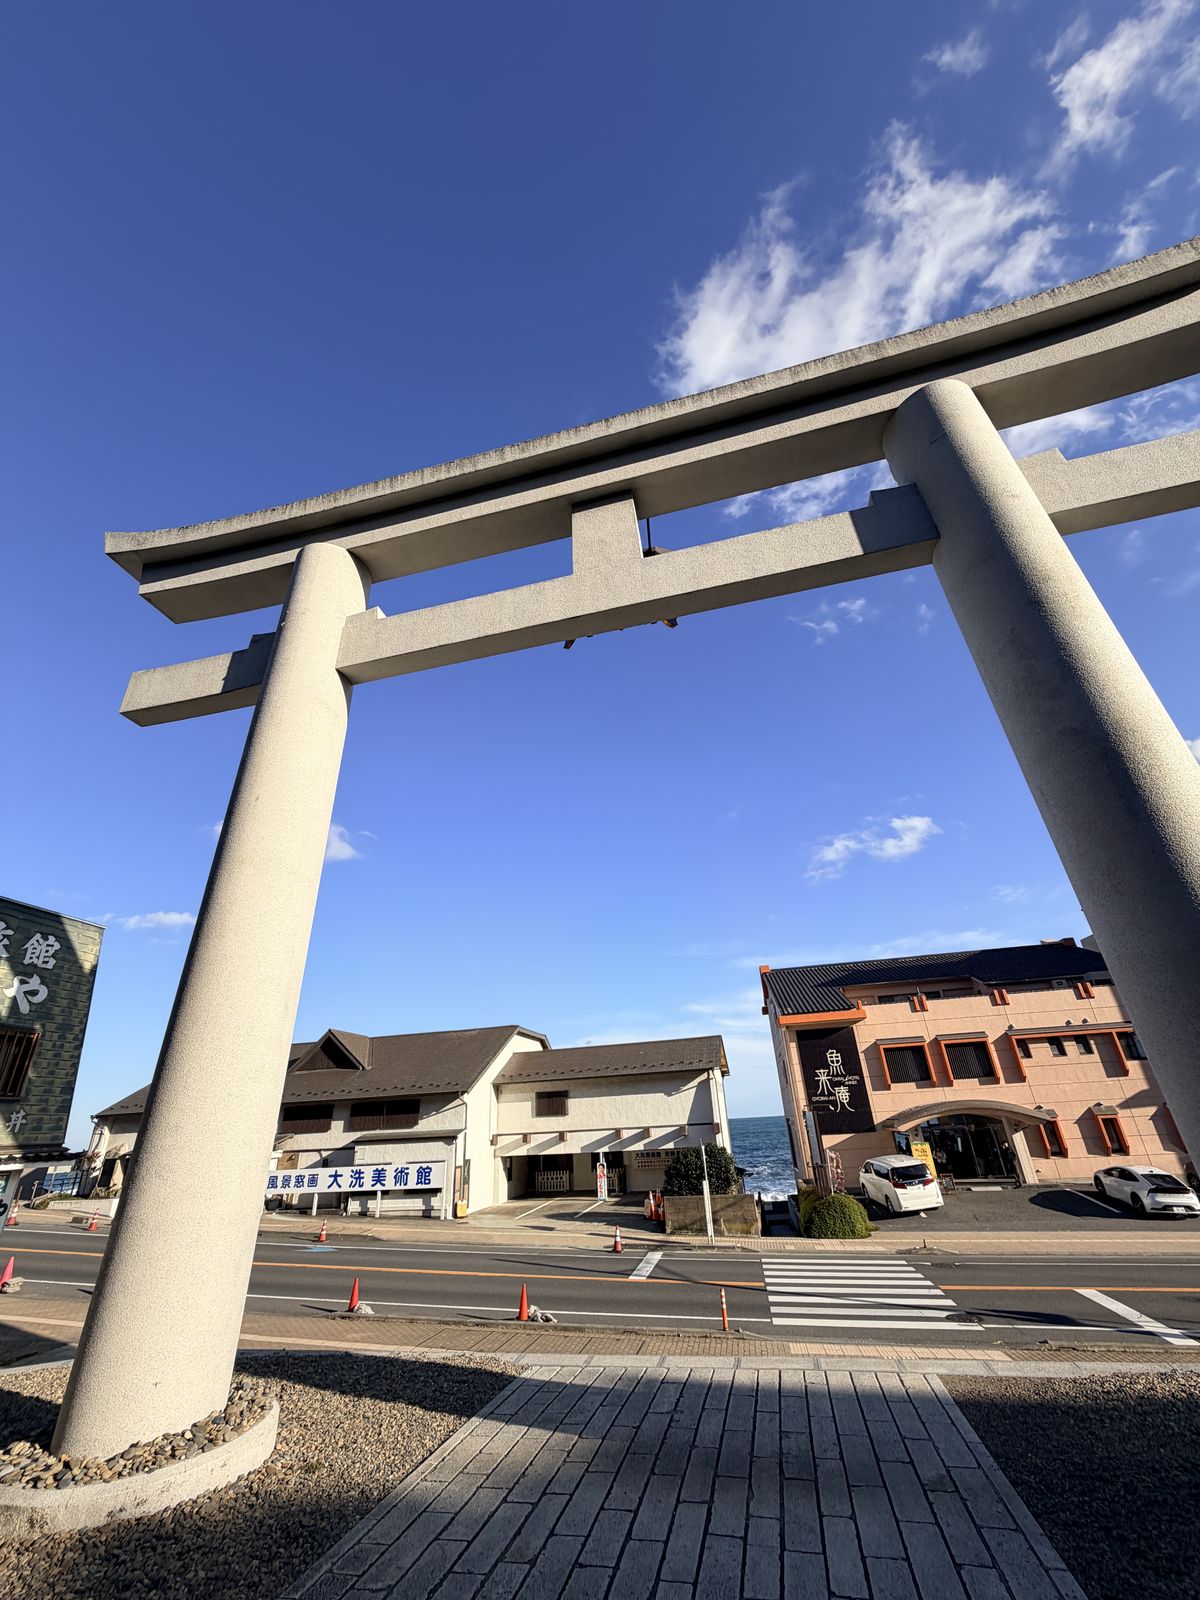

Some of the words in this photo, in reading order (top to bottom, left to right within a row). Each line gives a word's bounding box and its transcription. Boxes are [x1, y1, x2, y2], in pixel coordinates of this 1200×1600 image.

[3, 973, 49, 1015] や
[327, 1165, 433, 1190] 大洗美術館
